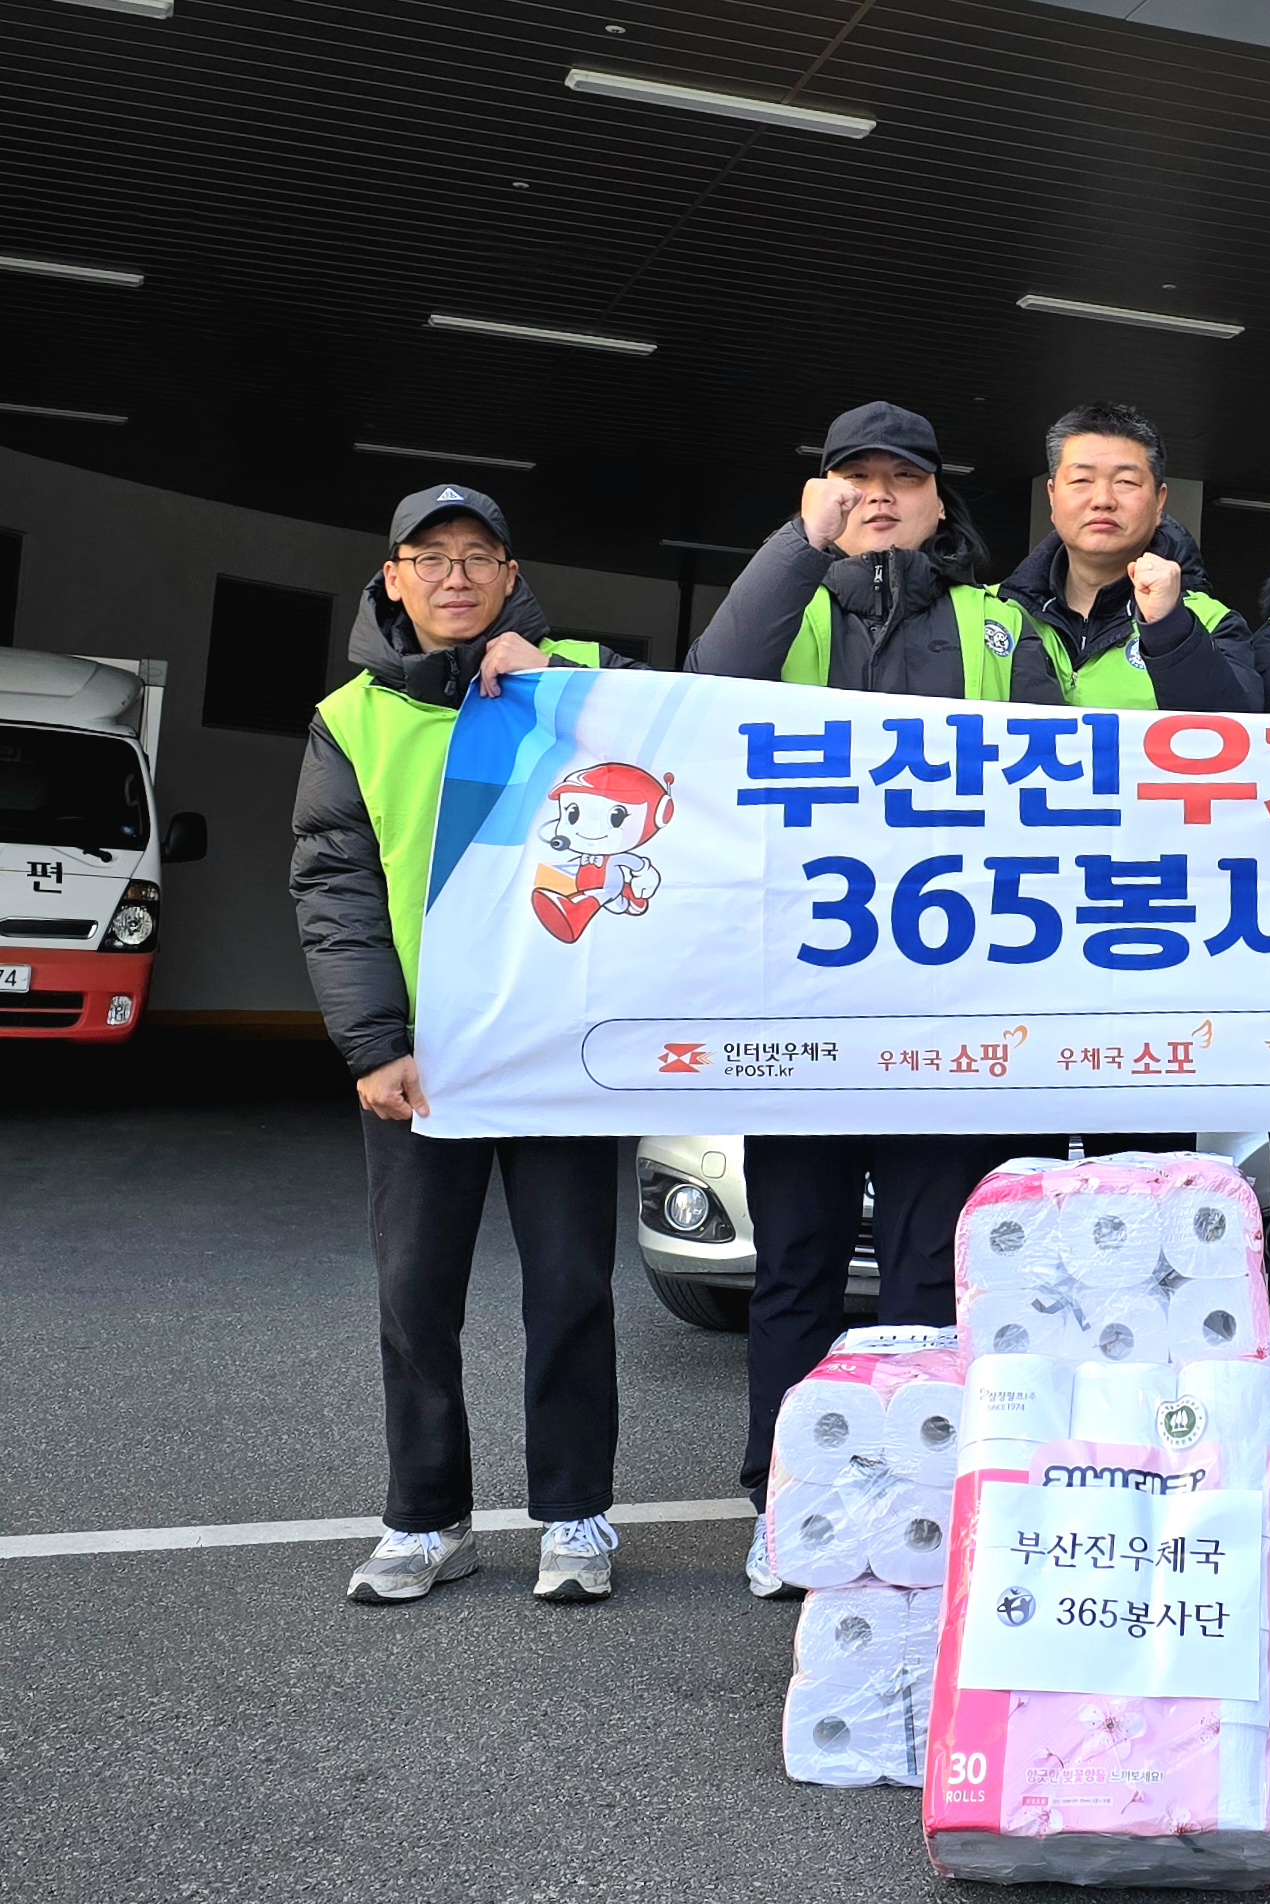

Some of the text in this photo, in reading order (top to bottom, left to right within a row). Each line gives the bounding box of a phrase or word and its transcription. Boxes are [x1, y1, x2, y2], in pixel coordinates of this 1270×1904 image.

[26, 861, 62, 894] 편
[723, 1042, 839, 1062] 인터넷우체국
[877, 1043, 1009, 1077] 우체국 쇼핑
[1057, 1041, 1196, 1075] 우체국 소포
[724, 1064, 795, 1077] ePOST.kr
[1007, 1402, 1025, 1411] 1974
[1010, 1531, 1227, 1575] 부산진우체국
[1056, 1597, 1231, 1639] 365봉사단
[947, 1752, 988, 1785] 30
[945, 1790, 986, 1804] ROLLS
